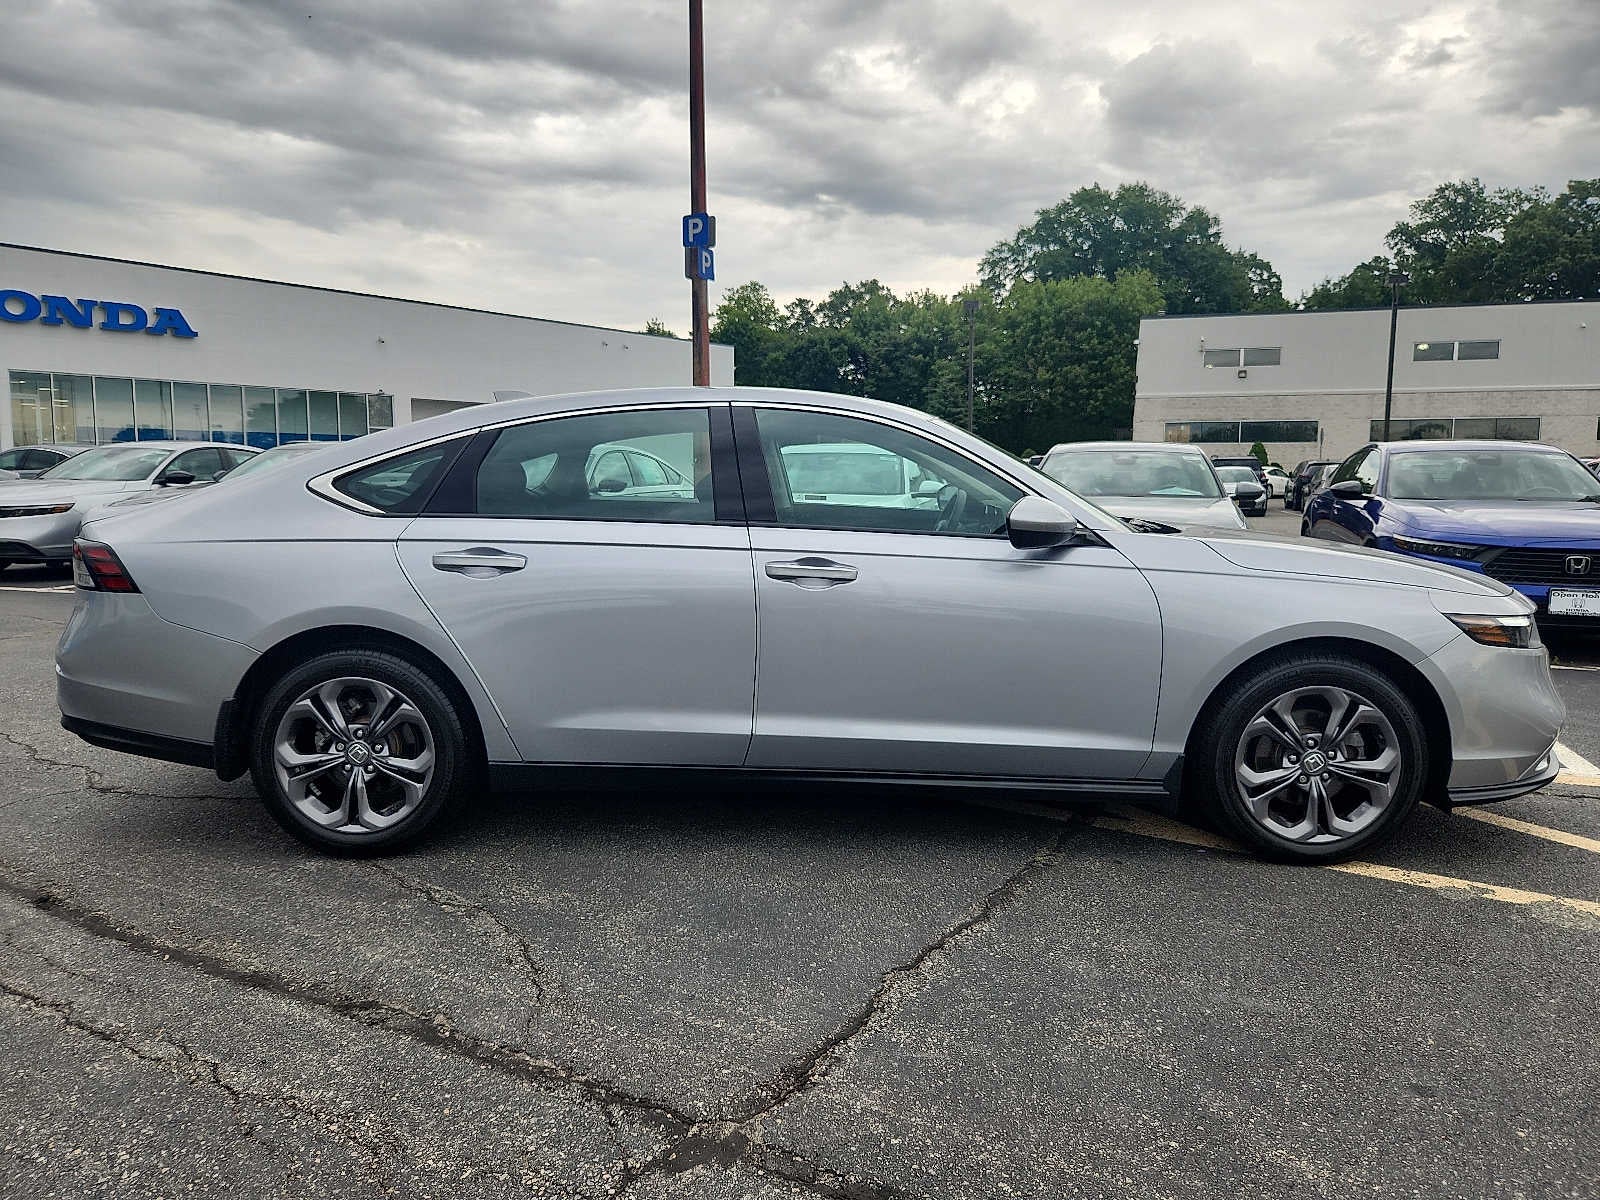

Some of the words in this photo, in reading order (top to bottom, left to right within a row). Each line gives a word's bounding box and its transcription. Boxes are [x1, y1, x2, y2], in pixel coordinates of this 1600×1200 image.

[688, 218, 704, 243] P
[702, 250, 712, 274] P
[0, 289, 199, 338] ONDA
[1552, 591, 1578, 599] Open
